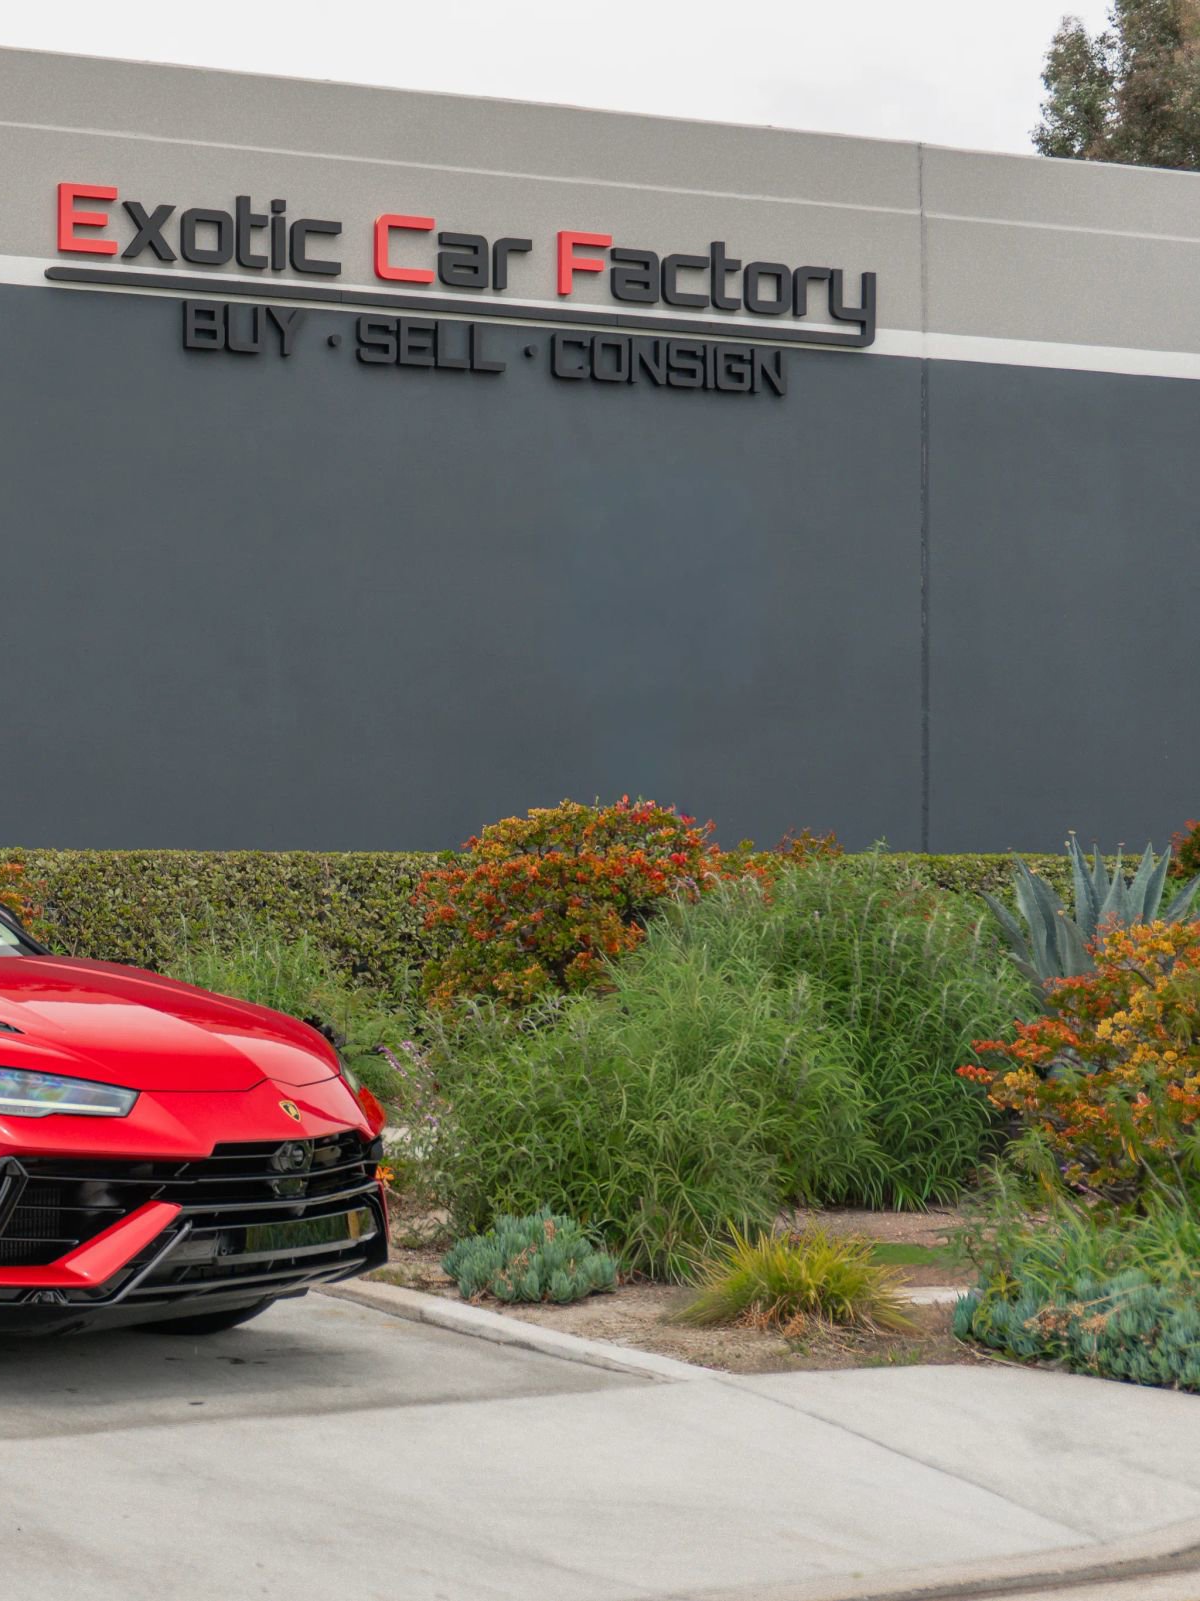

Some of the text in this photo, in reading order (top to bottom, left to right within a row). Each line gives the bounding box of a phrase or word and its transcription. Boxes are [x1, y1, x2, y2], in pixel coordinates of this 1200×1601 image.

[57, 182, 877, 348] Exotic Car Factory
[183, 300, 788, 396] BUY SELL CONSIGN
